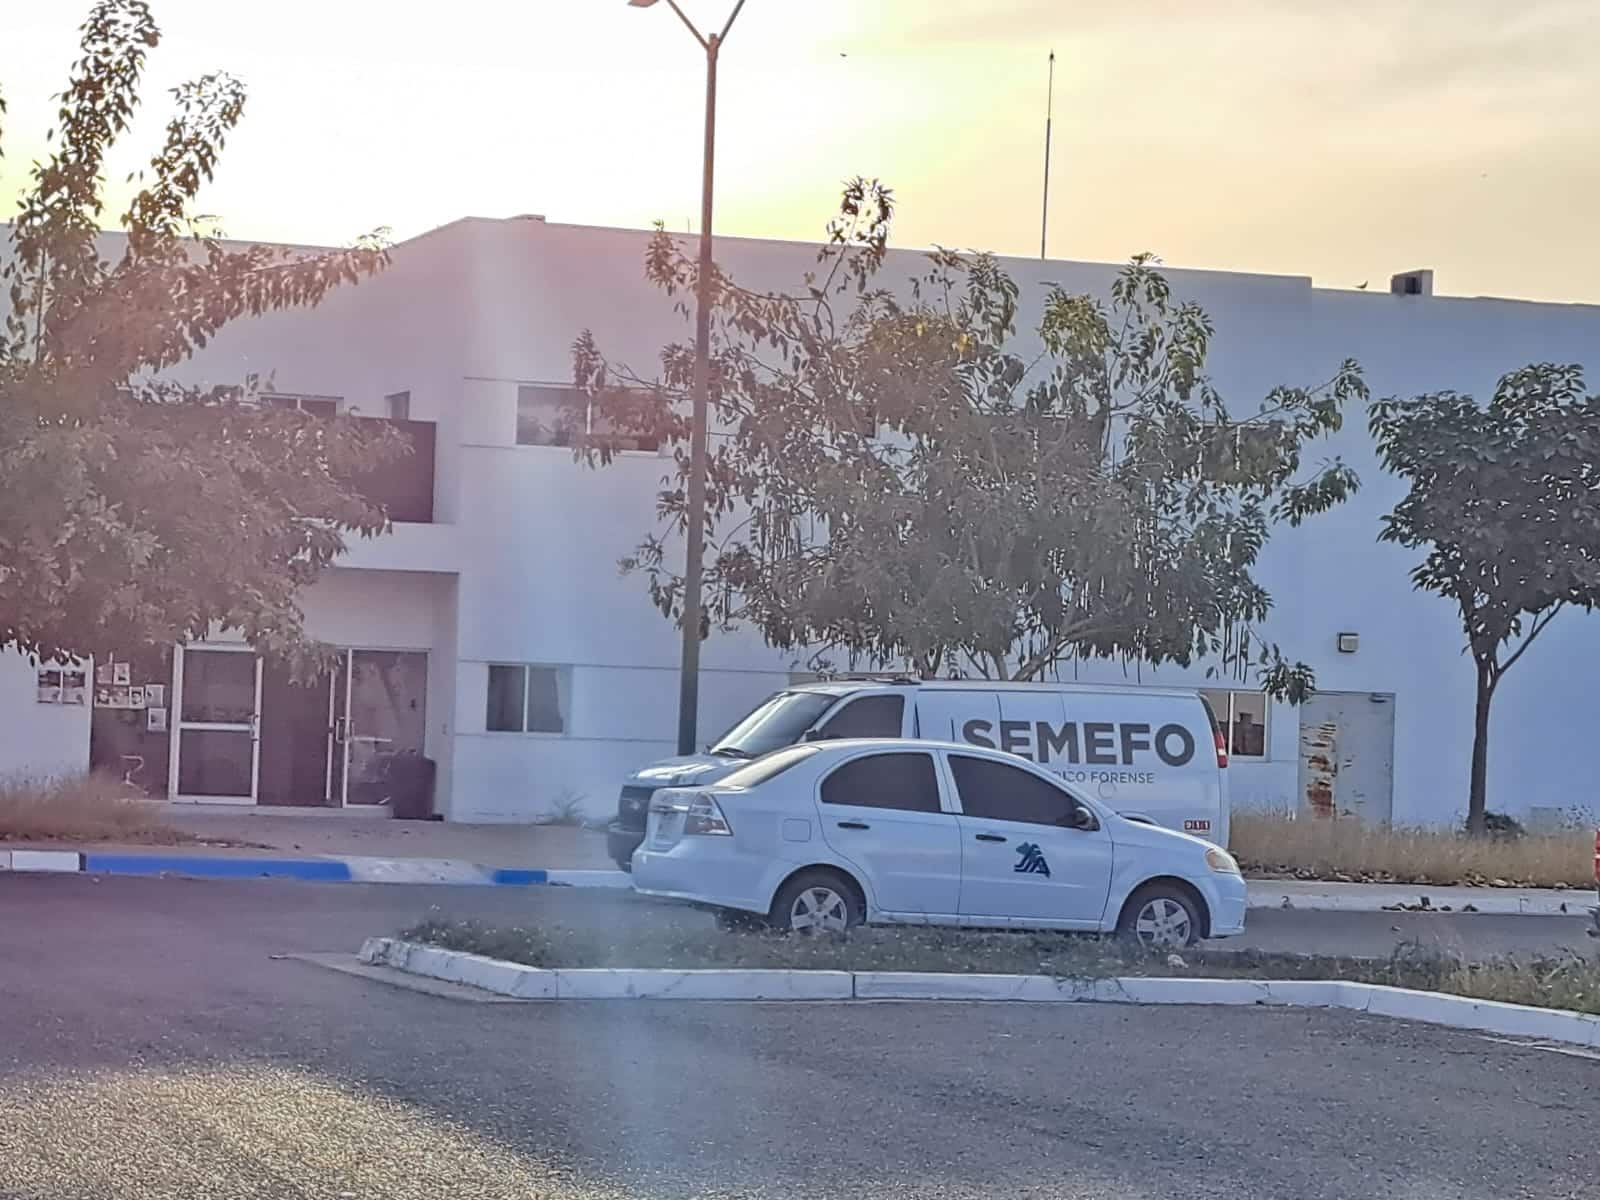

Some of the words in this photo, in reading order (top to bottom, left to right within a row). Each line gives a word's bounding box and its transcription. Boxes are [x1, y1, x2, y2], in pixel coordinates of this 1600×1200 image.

[963, 719, 1195, 766] SEMEFO
[1090, 771, 1154, 784] FORENSE
[1185, 820, 1209, 830] 911
